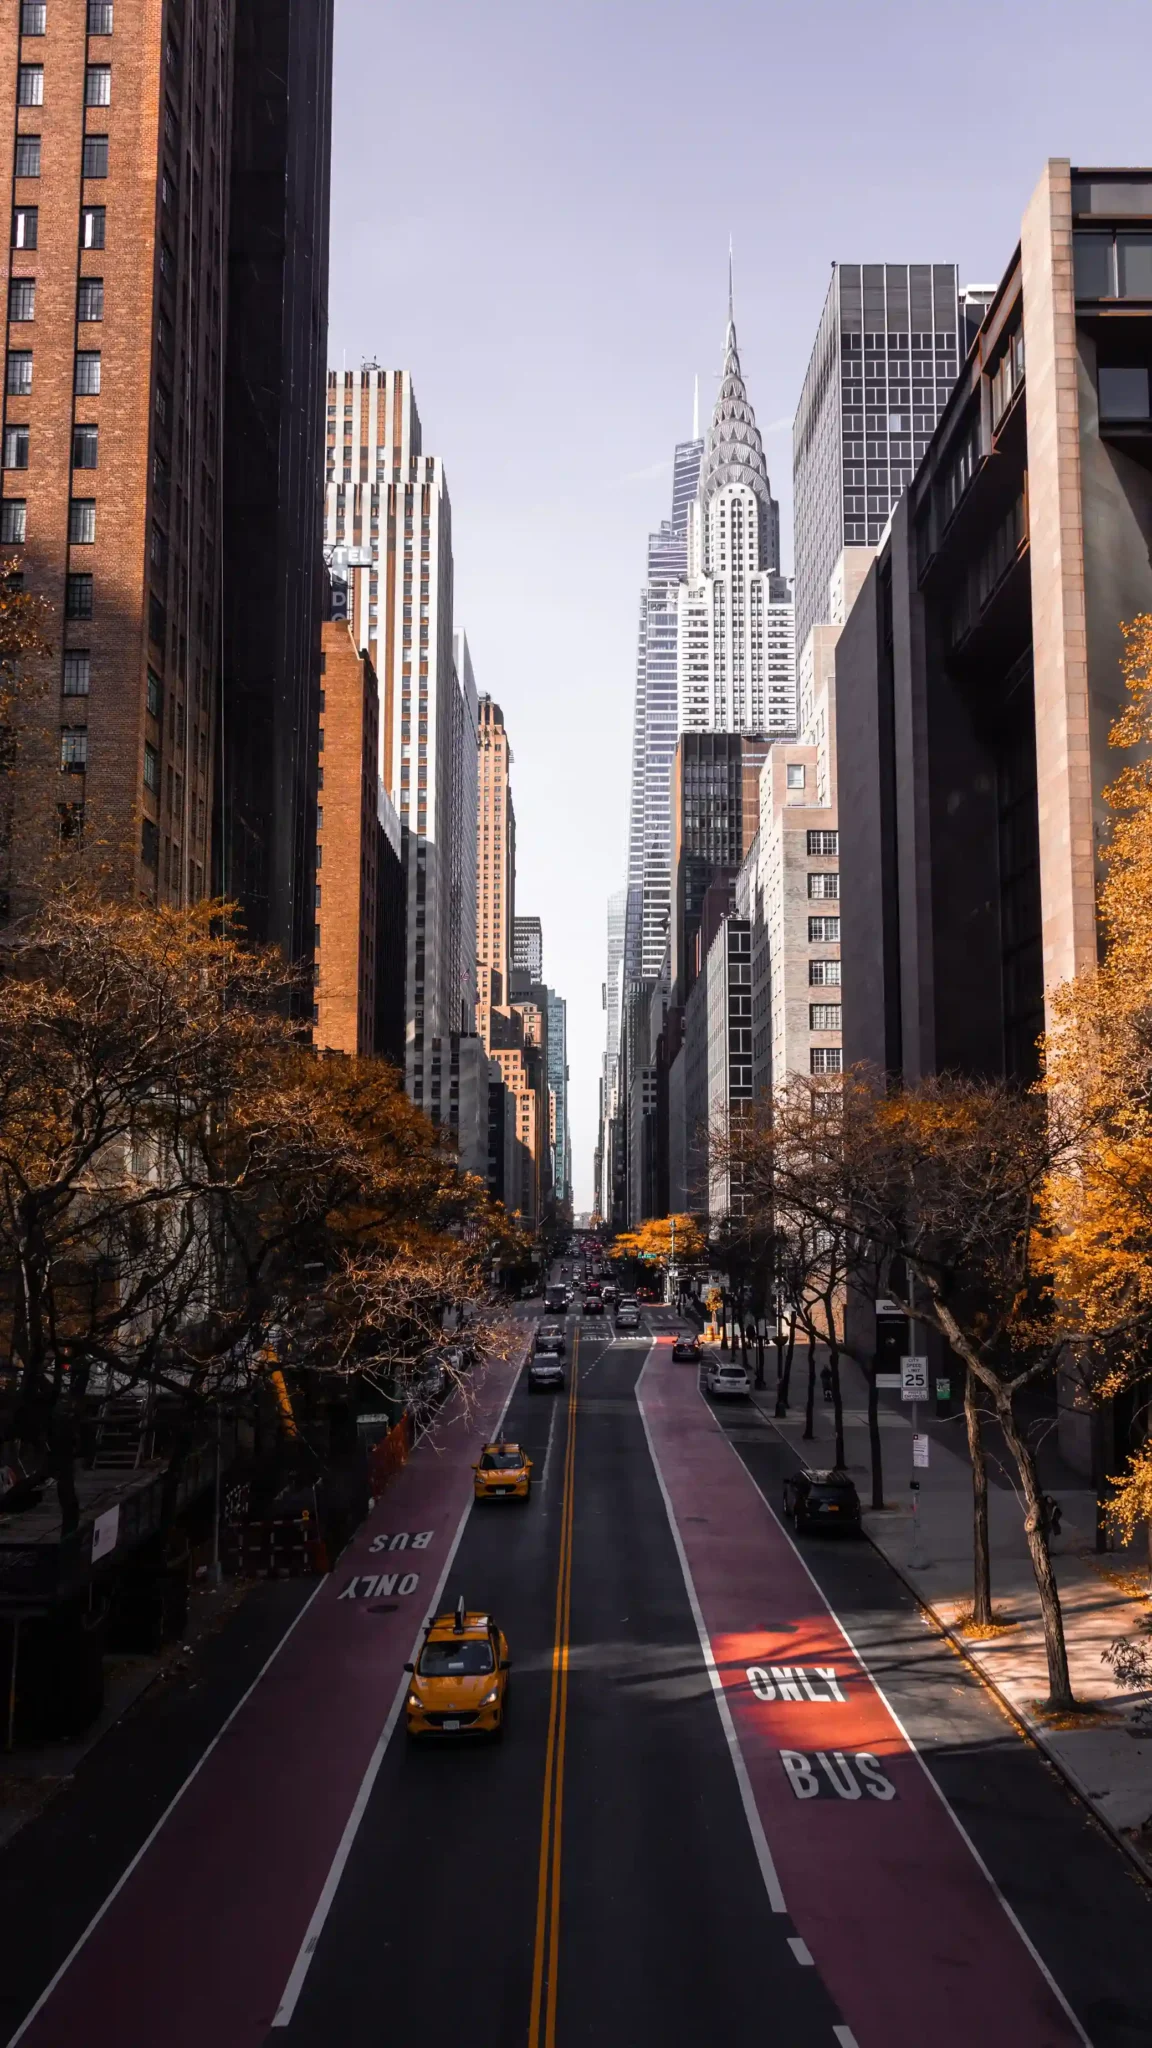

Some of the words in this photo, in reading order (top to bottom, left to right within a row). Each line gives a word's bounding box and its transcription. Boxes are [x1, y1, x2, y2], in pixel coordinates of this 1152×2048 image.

[331, 547, 371, 564] TEL
[905, 1374, 925, 1386] 25
[368, 1531, 434, 1553] BUS
[336, 1572, 419, 1600] ONLY
[745, 1666, 846, 1702] ONLY
[779, 1749, 897, 1801] BUS
